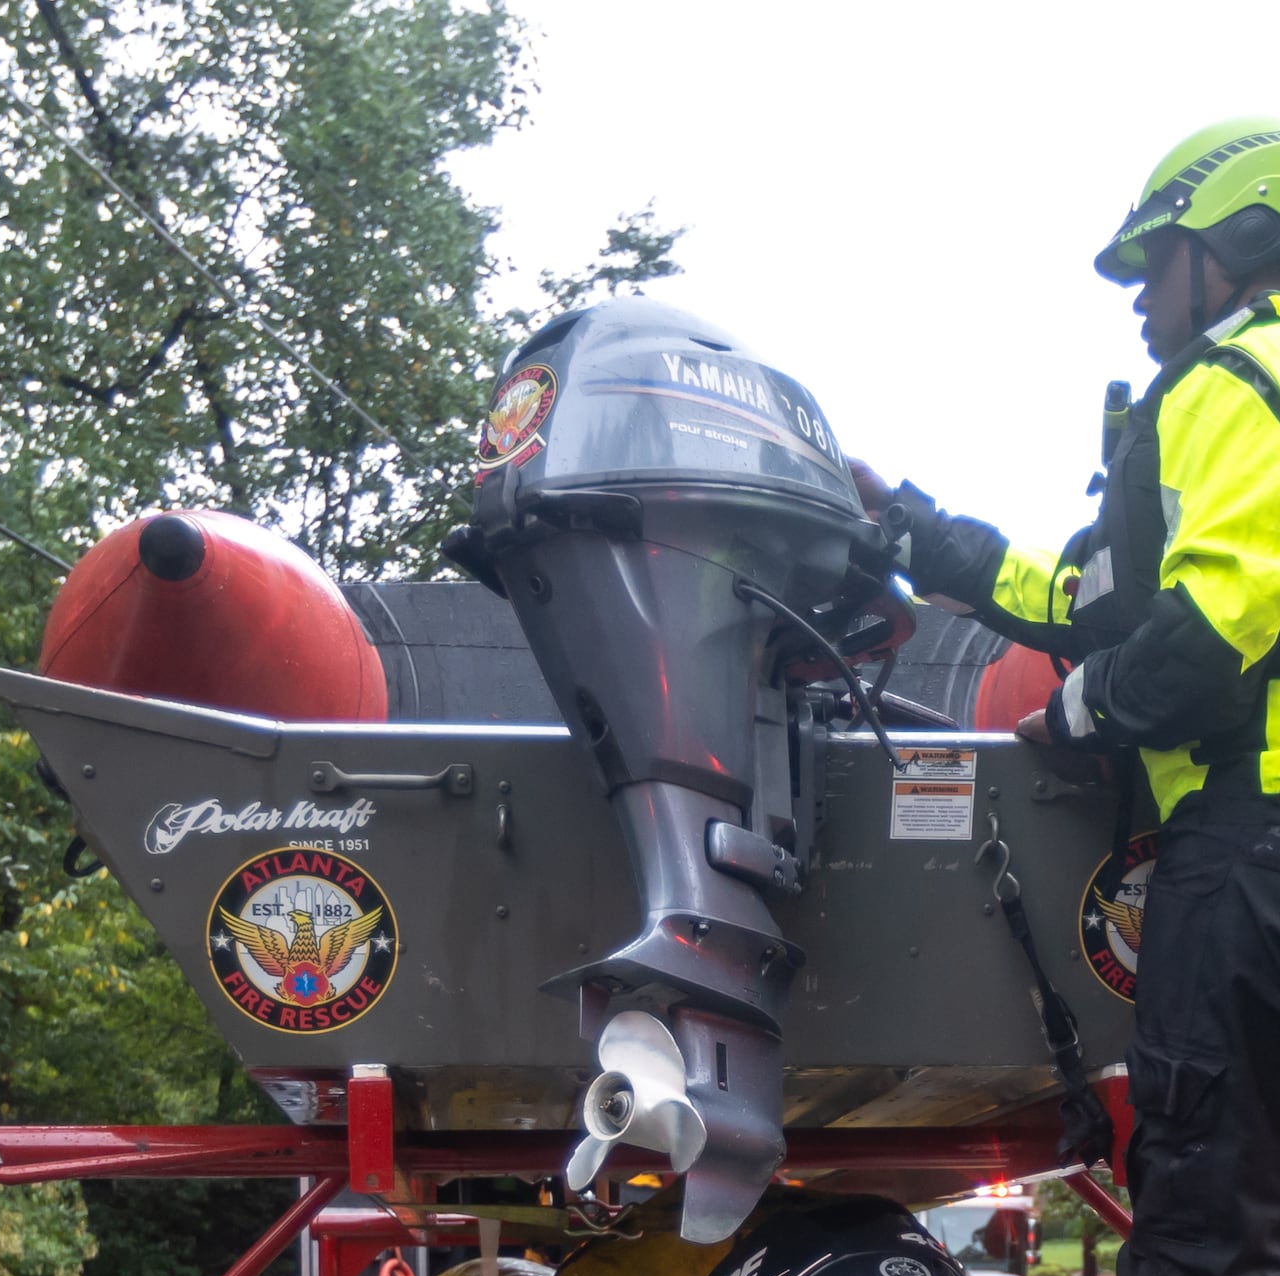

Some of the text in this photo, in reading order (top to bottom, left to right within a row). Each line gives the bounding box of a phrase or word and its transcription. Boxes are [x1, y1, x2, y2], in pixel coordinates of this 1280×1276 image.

[1120, 211, 1172, 242] WRSI
[661, 351, 771, 415] YAMAHA
[162, 797, 377, 852] Polar Kraft
[338, 838, 370, 851] 1951
[239, 852, 367, 899] ATLANTA
[315, 903, 353, 918] 1882
[1091, 949, 1137, 996] FIRE
[223, 970, 382, 1030] FIRE RESCUE
